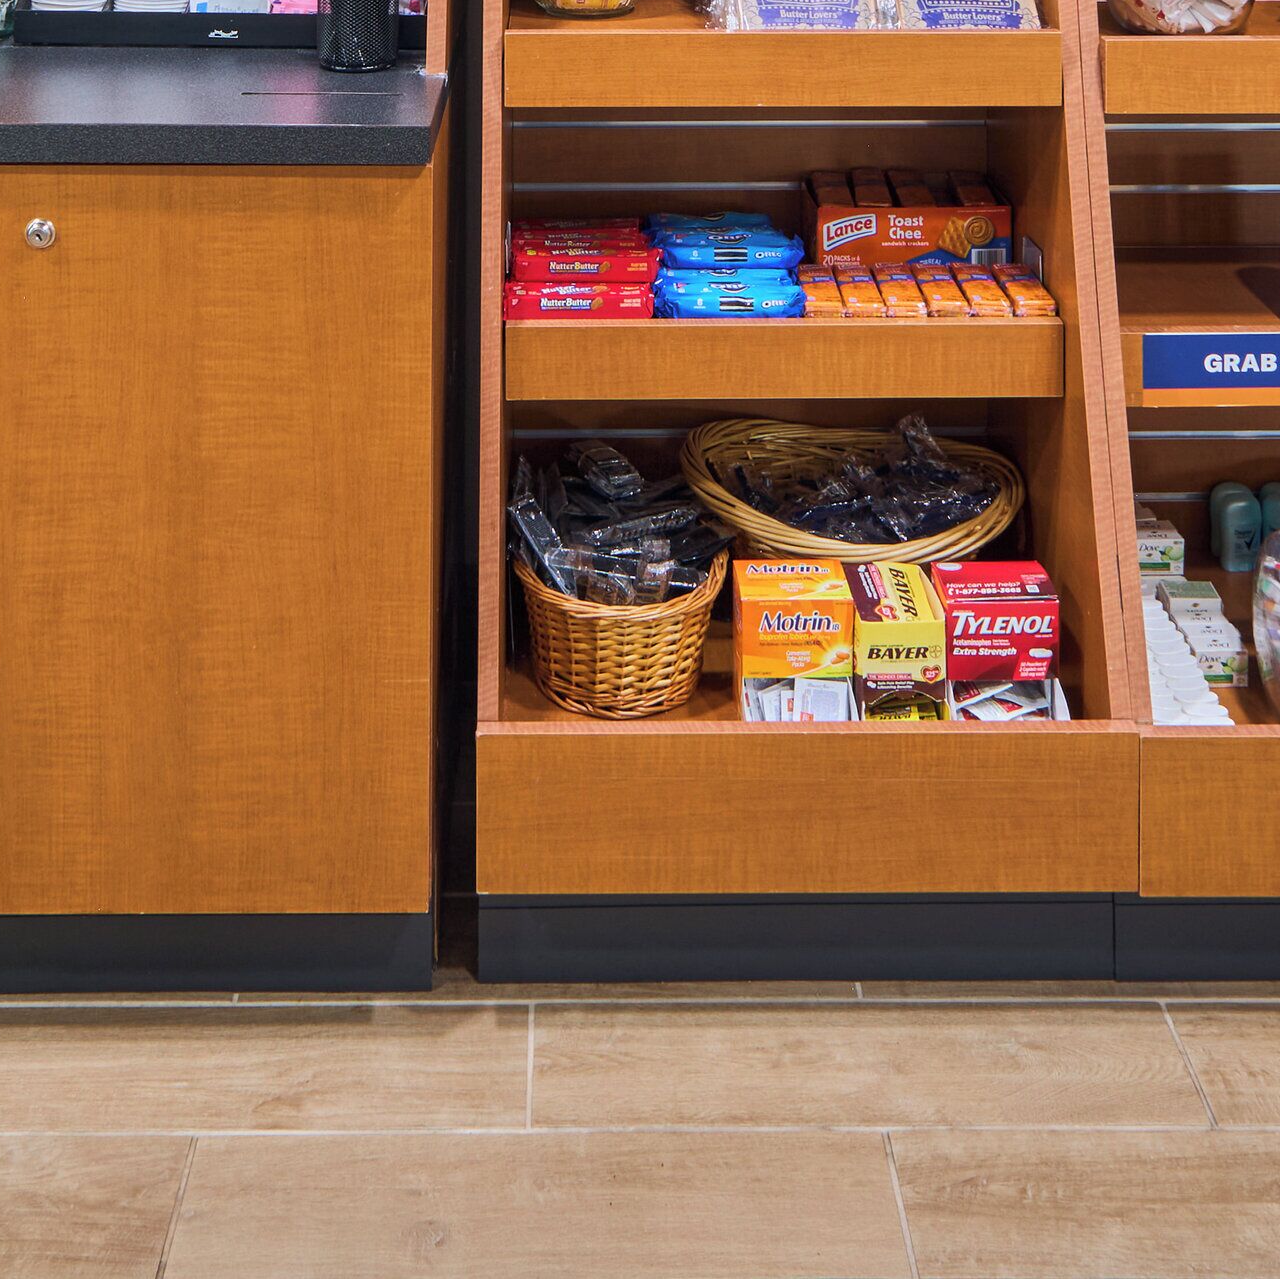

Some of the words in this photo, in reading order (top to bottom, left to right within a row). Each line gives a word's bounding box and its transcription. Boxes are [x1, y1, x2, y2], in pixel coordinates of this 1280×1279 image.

[780, 9, 809, 20] Butter
[809, 10, 838, 20] Lovers
[943, 11, 972, 21] Butter
[973, 11, 1001, 21] Lovers
[888, 214, 924, 227] Toast
[826, 218, 873, 242] Lance
[823, 254, 834, 266] 20
[1203, 353, 1277, 374] GRAB
[1138, 543, 1160, 552] Dove
[747, 564, 820, 575] Motrin
[889, 567, 918, 617] BAYER
[759, 611, 832, 632] Motrin
[951, 612, 1054, 637] TYLENOL
[867, 646, 930, 660] BAYER
[953, 647, 977, 656] Extra
[978, 647, 1017, 657] Strength
[1198, 655, 1222, 664] Dove
